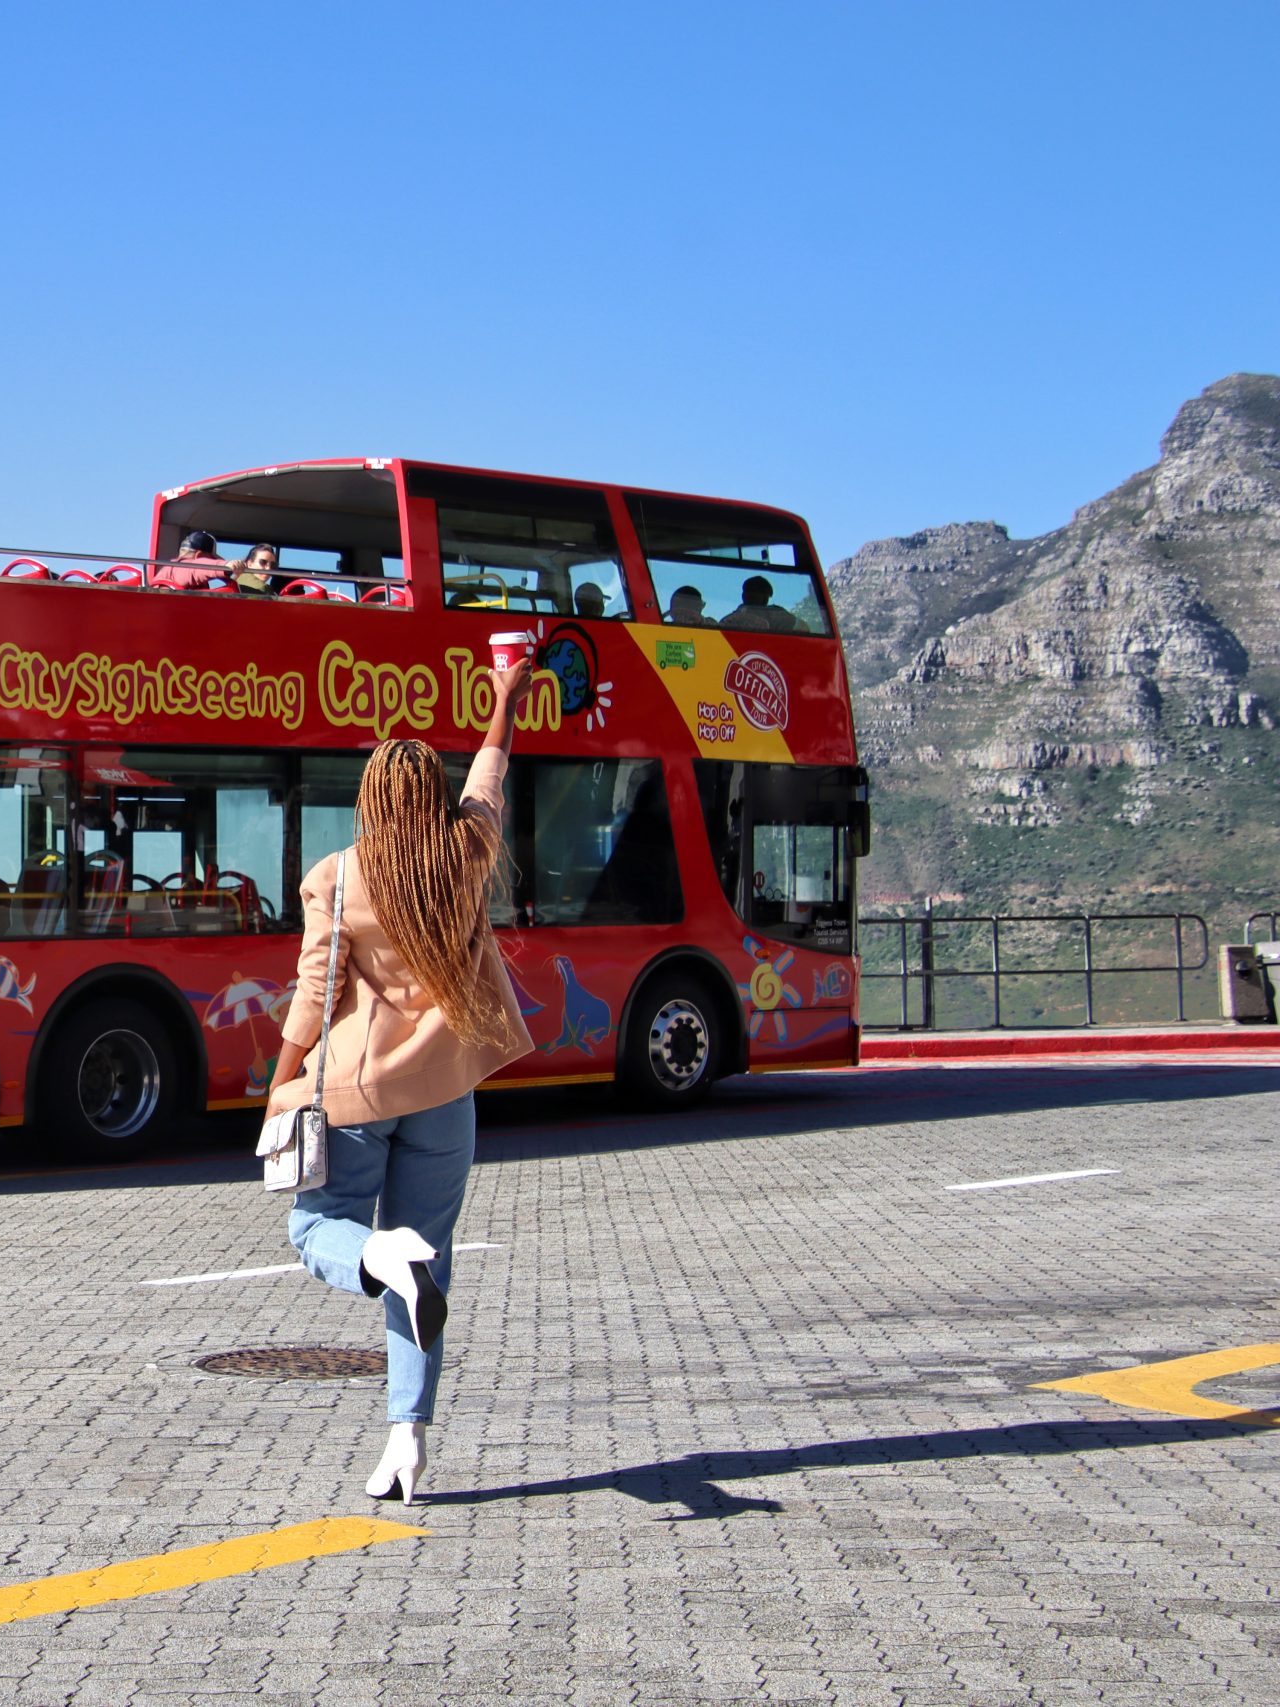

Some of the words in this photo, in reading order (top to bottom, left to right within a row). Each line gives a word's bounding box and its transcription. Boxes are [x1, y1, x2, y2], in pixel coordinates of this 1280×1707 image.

[318, 640, 439, 741] Cape
[735, 667, 783, 720] OFFICIAL
[698, 702, 718, 721] Hop
[719, 702, 734, 721] On
[751, 706, 768, 724] TOUR
[698, 722, 718, 742] Hop
[719, 723, 736, 742] Off
